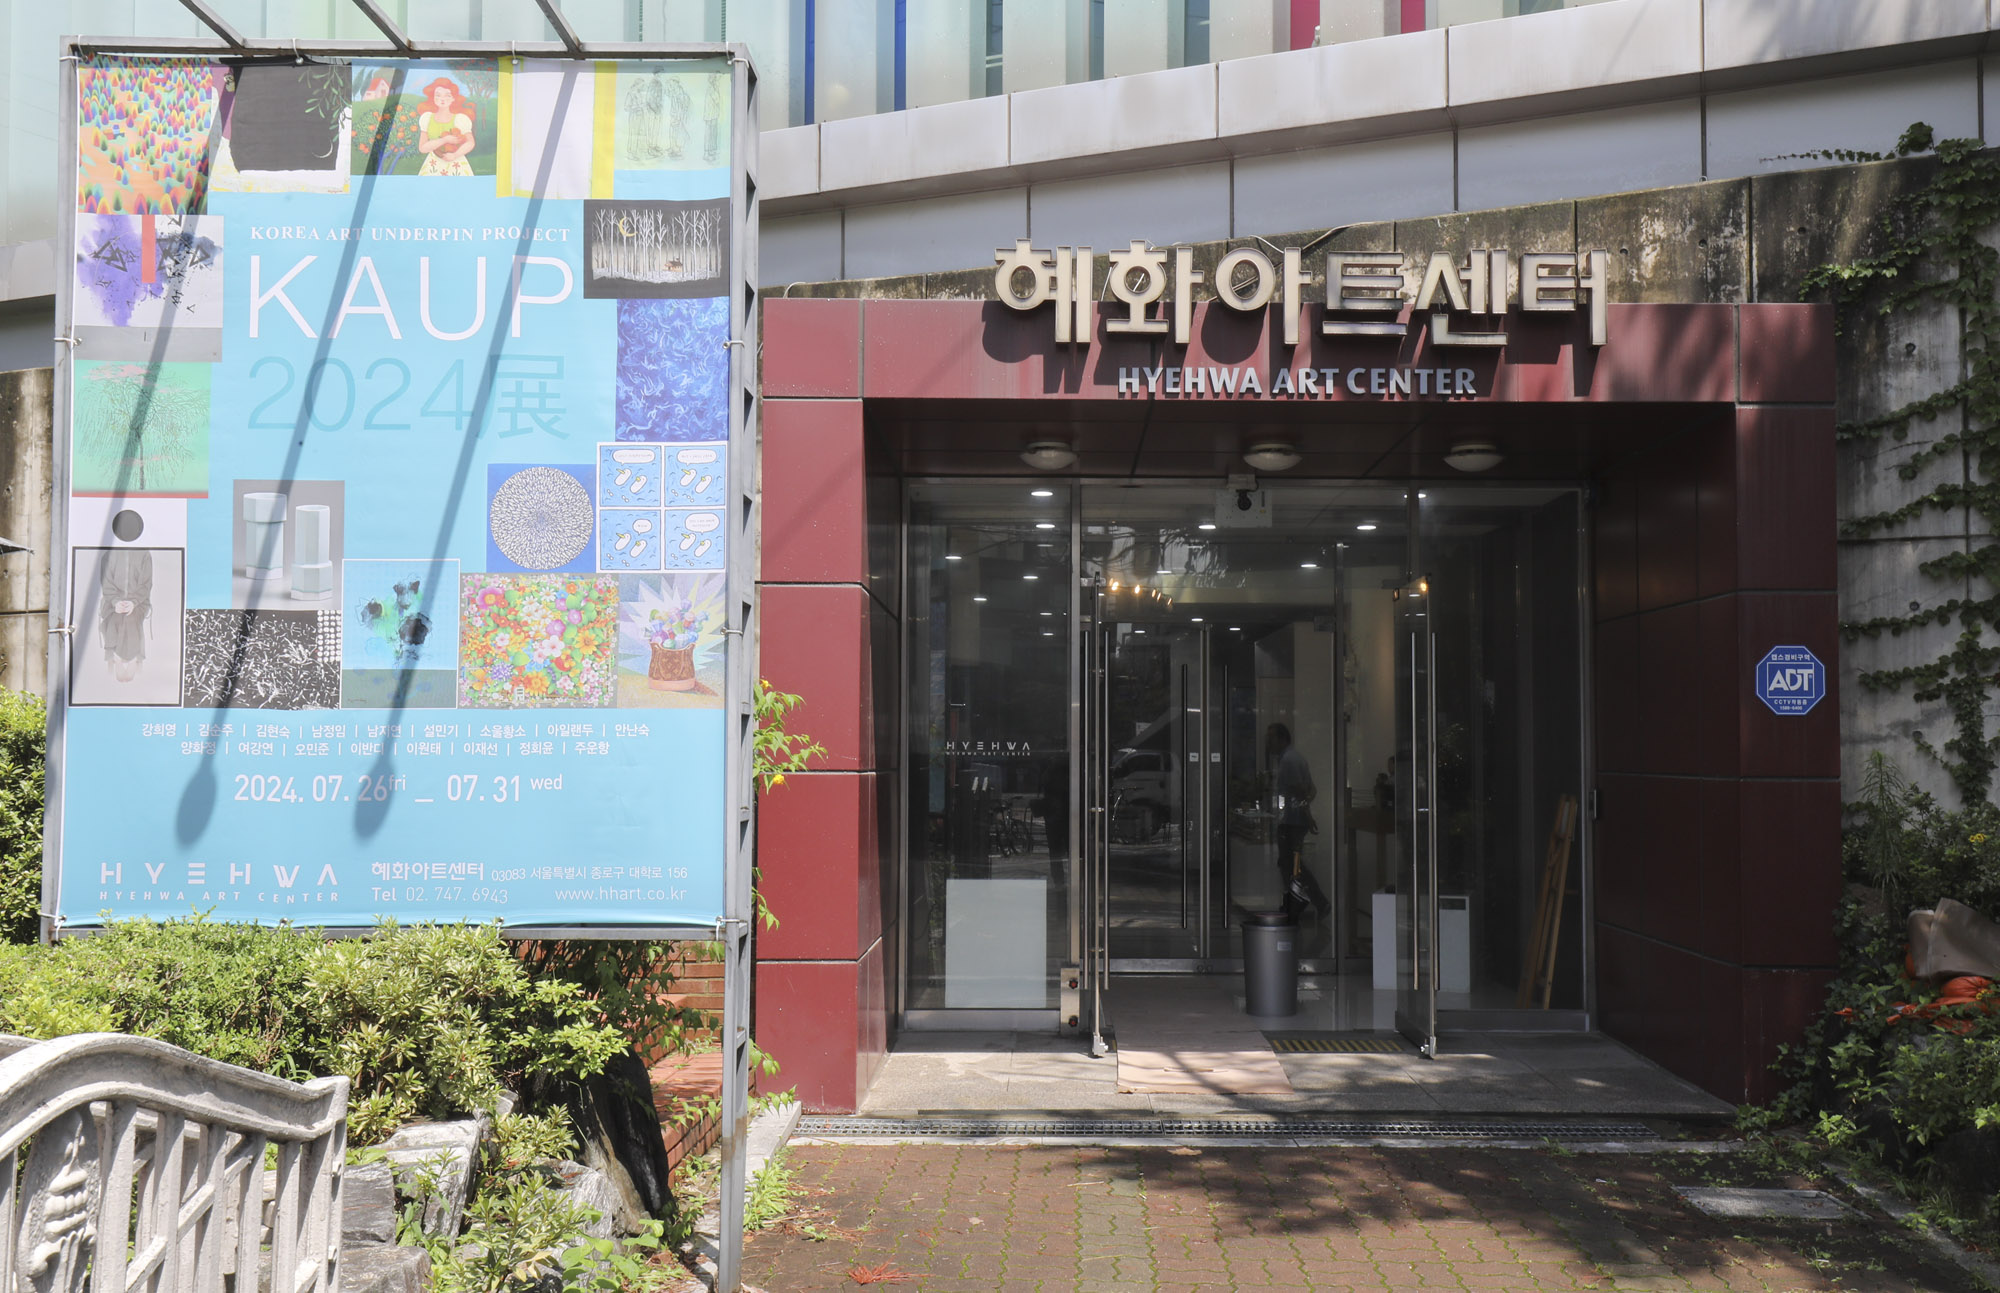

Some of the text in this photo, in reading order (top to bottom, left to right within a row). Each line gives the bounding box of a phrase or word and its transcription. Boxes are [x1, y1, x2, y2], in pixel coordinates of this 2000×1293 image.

[251, 225, 570, 241] KOREA ART UNDERPIN PROJECT
[249, 254, 574, 341] KAUP
[994, 239, 1608, 346] 혜화아트센터
[1118, 367, 1477, 395] HYEHWA ART CENTER
[1768, 668, 1814, 691] ADT
[142, 723, 177, 737] 강희영
[256, 724, 291, 739] 김현숙
[312, 724, 346, 738] 남정임
[424, 724, 458, 738] 설민기
[480, 724, 526, 739] 소울황소
[547, 724, 594, 738] 아일랜두
[615, 724, 650, 737] 안난숙
[238, 742, 273, 756] 여강연
[294, 742, 330, 756] 오민준
[407, 742, 441, 755] 이원태
[464, 742, 498, 756] 이재선
[946, 741, 1030, 751] HYEHWA
[234, 774, 304, 802] 2024.
[312, 774, 349, 802] 07.
[447, 774, 485, 802] 07.
[492, 775, 520, 802] 31
[530, 774, 563, 790] wed
[100, 862, 338, 888] HYEHWA
[371, 861, 688, 882] 혜화아트센터 03083 서울특별시 종로구 대학로 156
[100, 891, 338, 904] HYEHWA ART CENTER
[372, 887, 397, 901] Tel
[472, 887, 509, 904] 6943
[554, 886, 688, 901] www.hhart.co.kr
